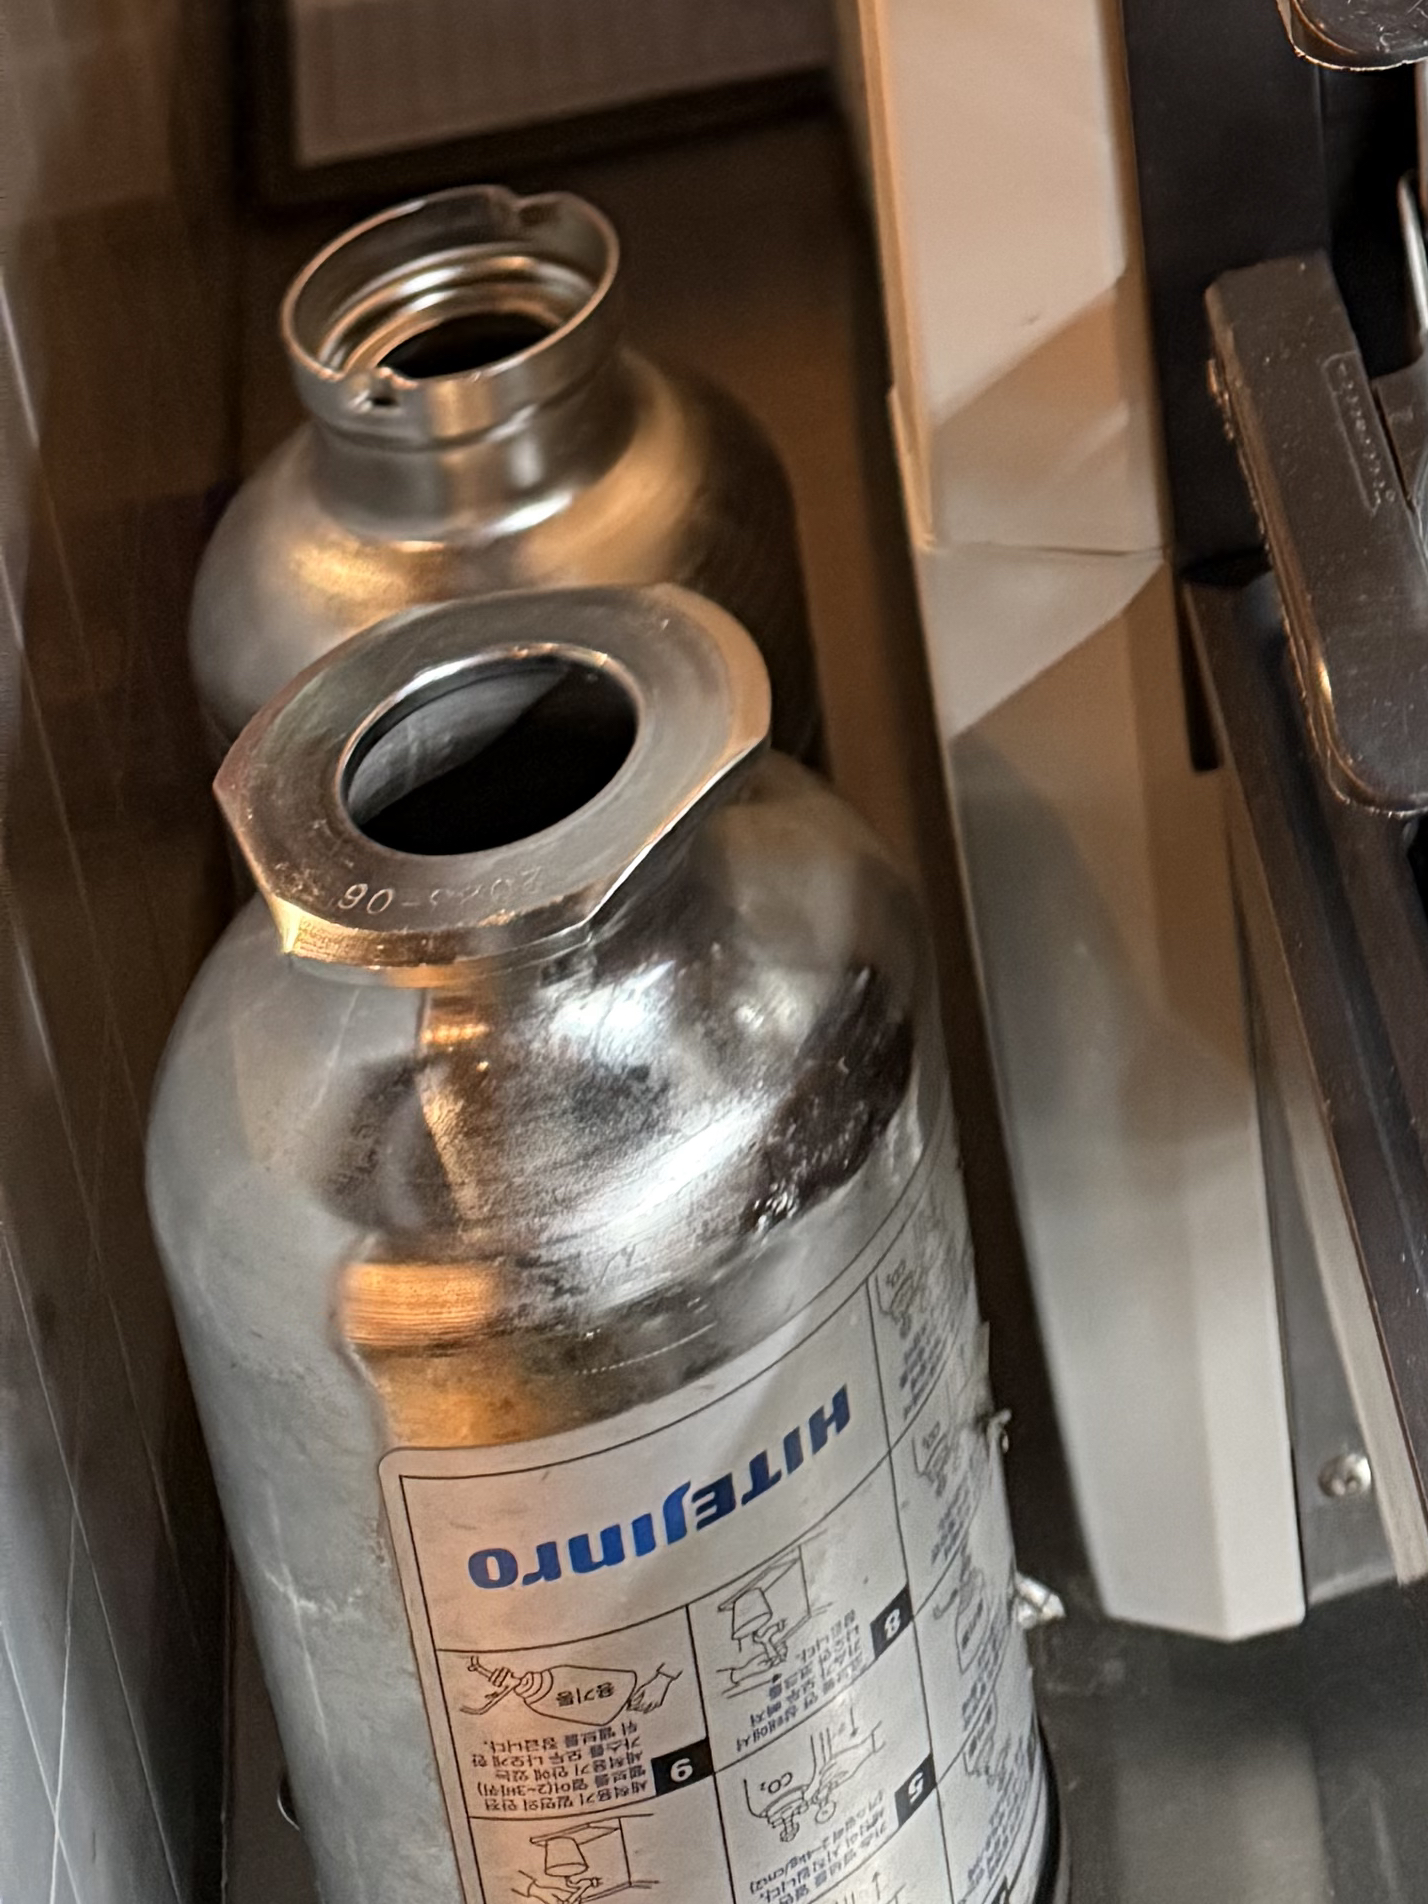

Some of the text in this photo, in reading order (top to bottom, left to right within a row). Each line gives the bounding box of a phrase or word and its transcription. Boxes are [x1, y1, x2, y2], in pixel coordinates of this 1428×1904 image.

[884, 1608, 900, 1641] 8
[556, 1682, 614, 1707] 용기통
[471, 1736, 640, 1768] 가스를 모두 나오게 한
[495, 1750, 643, 1783] 세척용기 안에 있는
[670, 1758, 693, 1783] 9
[578, 1780, 648, 1805] 세척용기
[907, 1772, 924, 1803] 5
[484, 1798, 517, 1812] 안전
